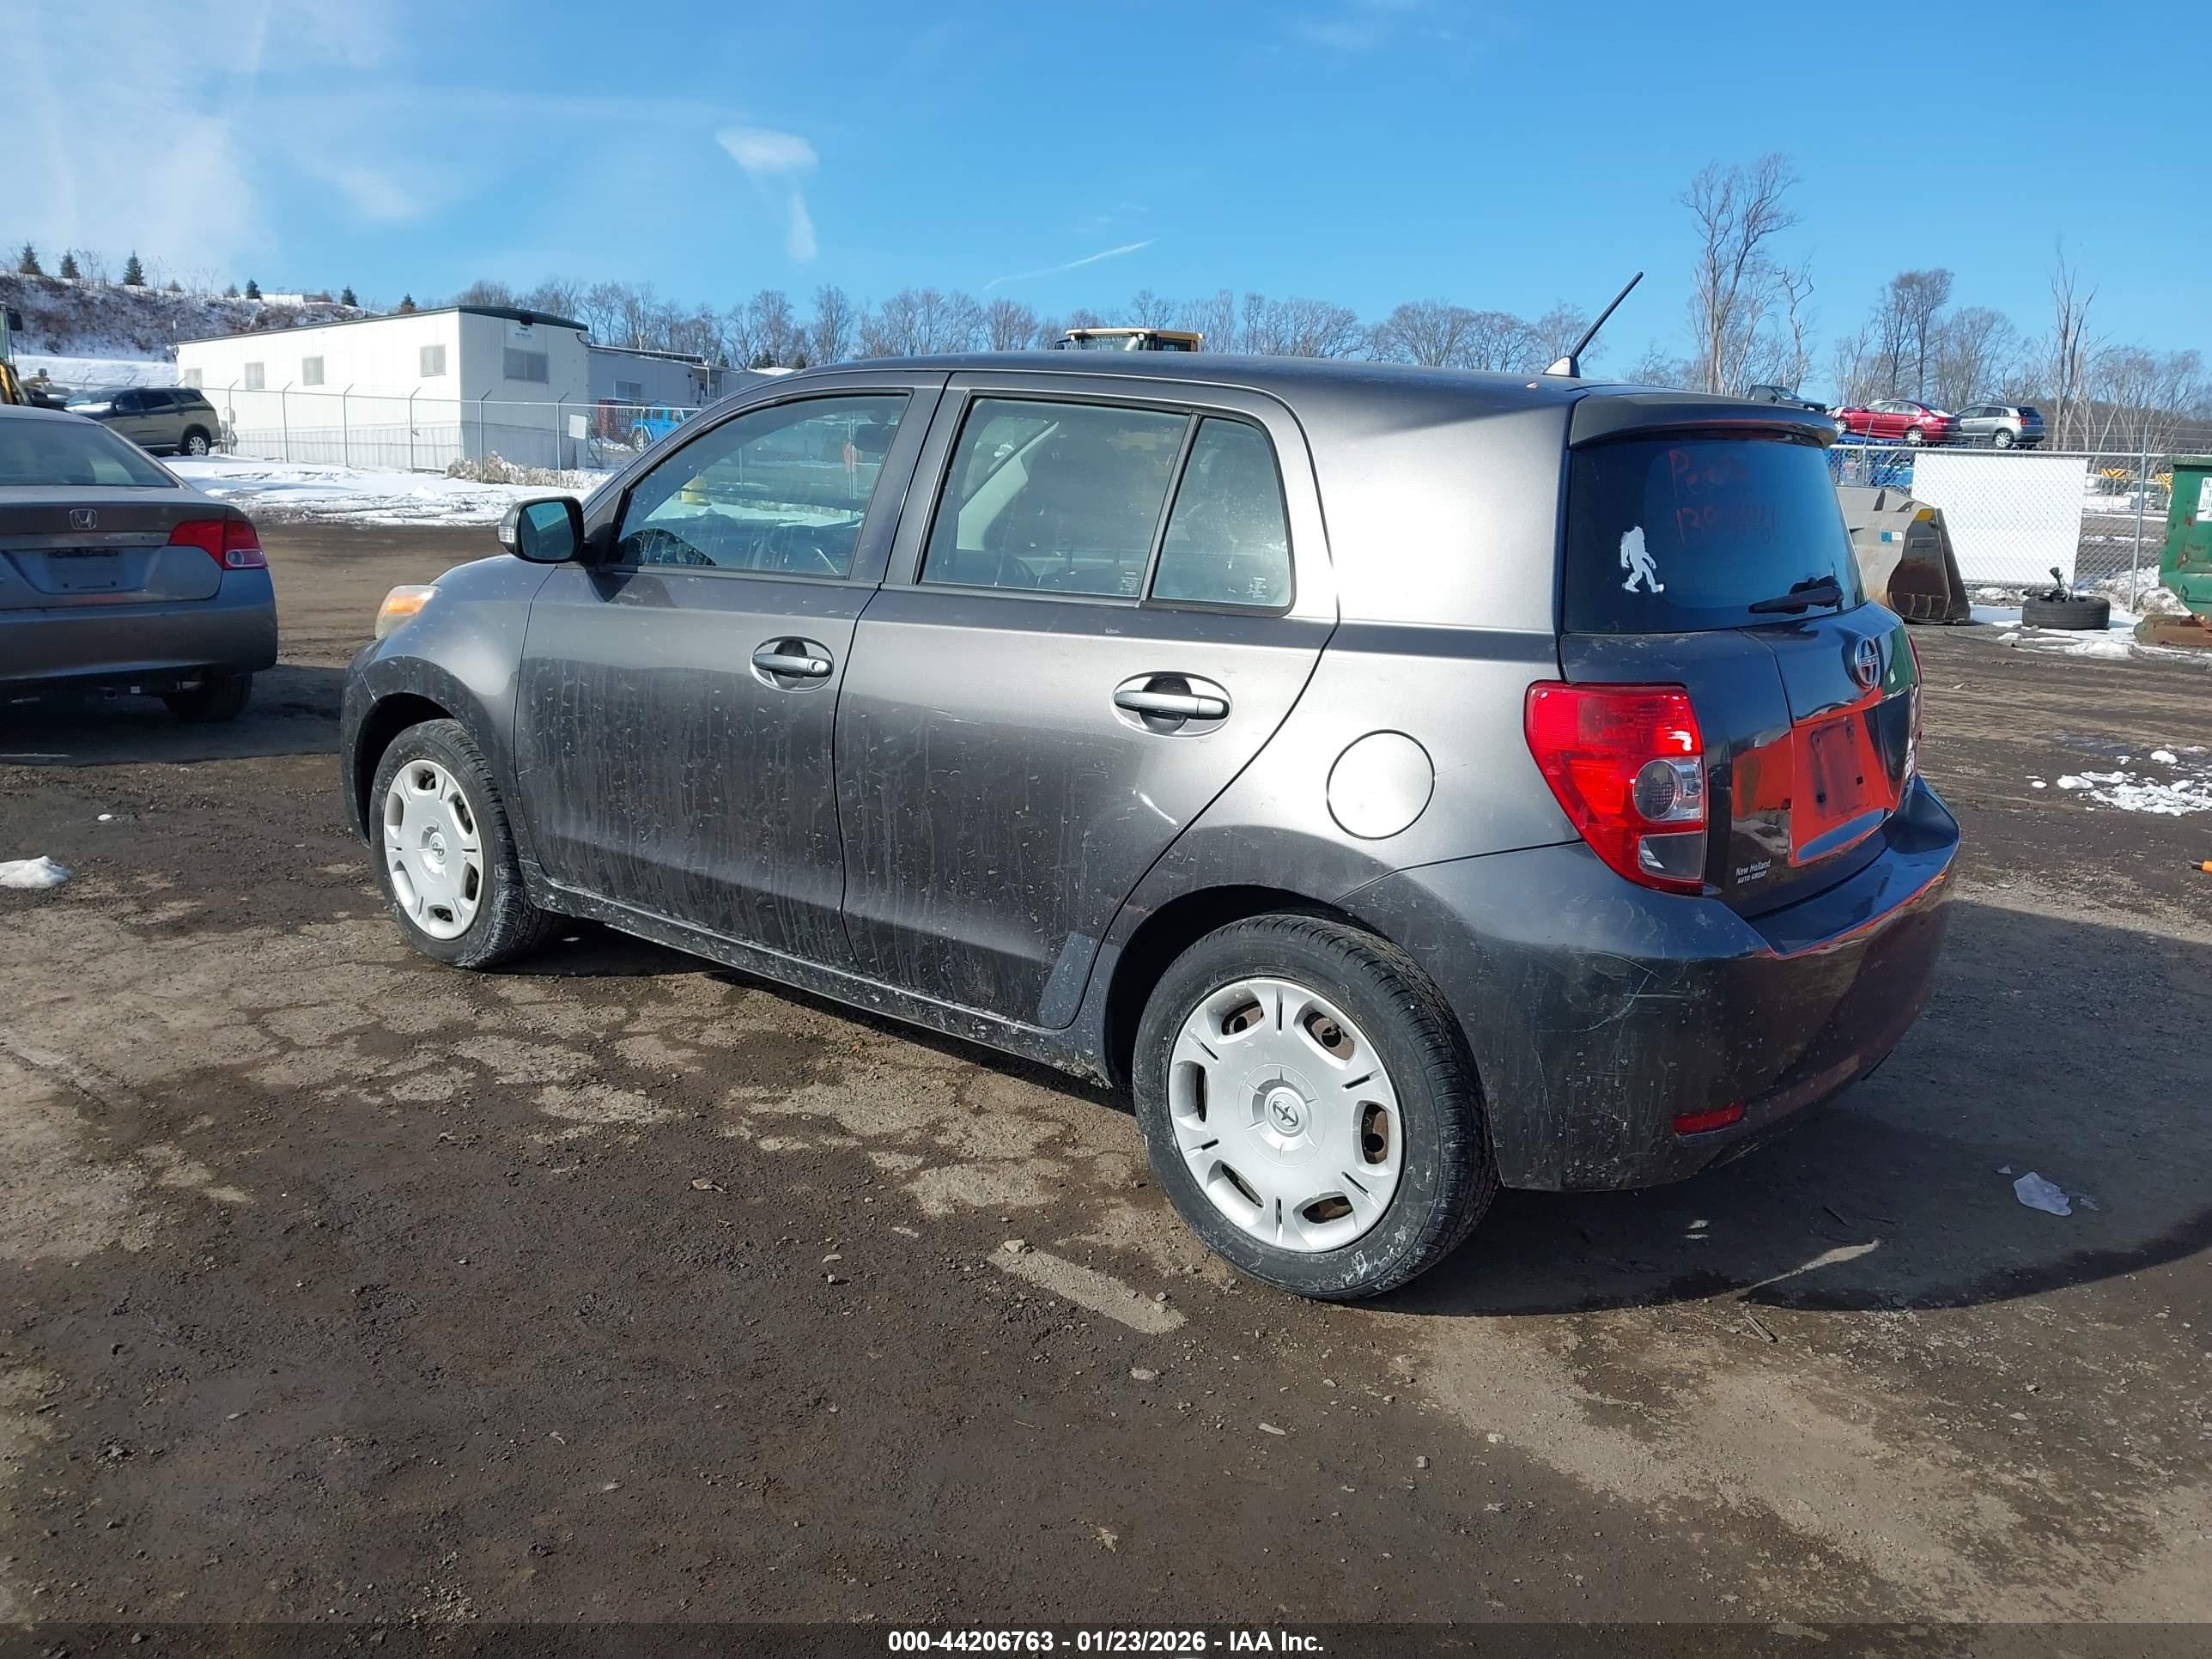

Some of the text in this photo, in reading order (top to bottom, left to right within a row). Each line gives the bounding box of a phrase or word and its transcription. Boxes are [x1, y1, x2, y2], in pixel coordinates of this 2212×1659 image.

[1735, 859, 1771, 876] New Holland
[1737, 870, 1767, 884] AUTO GROUP
